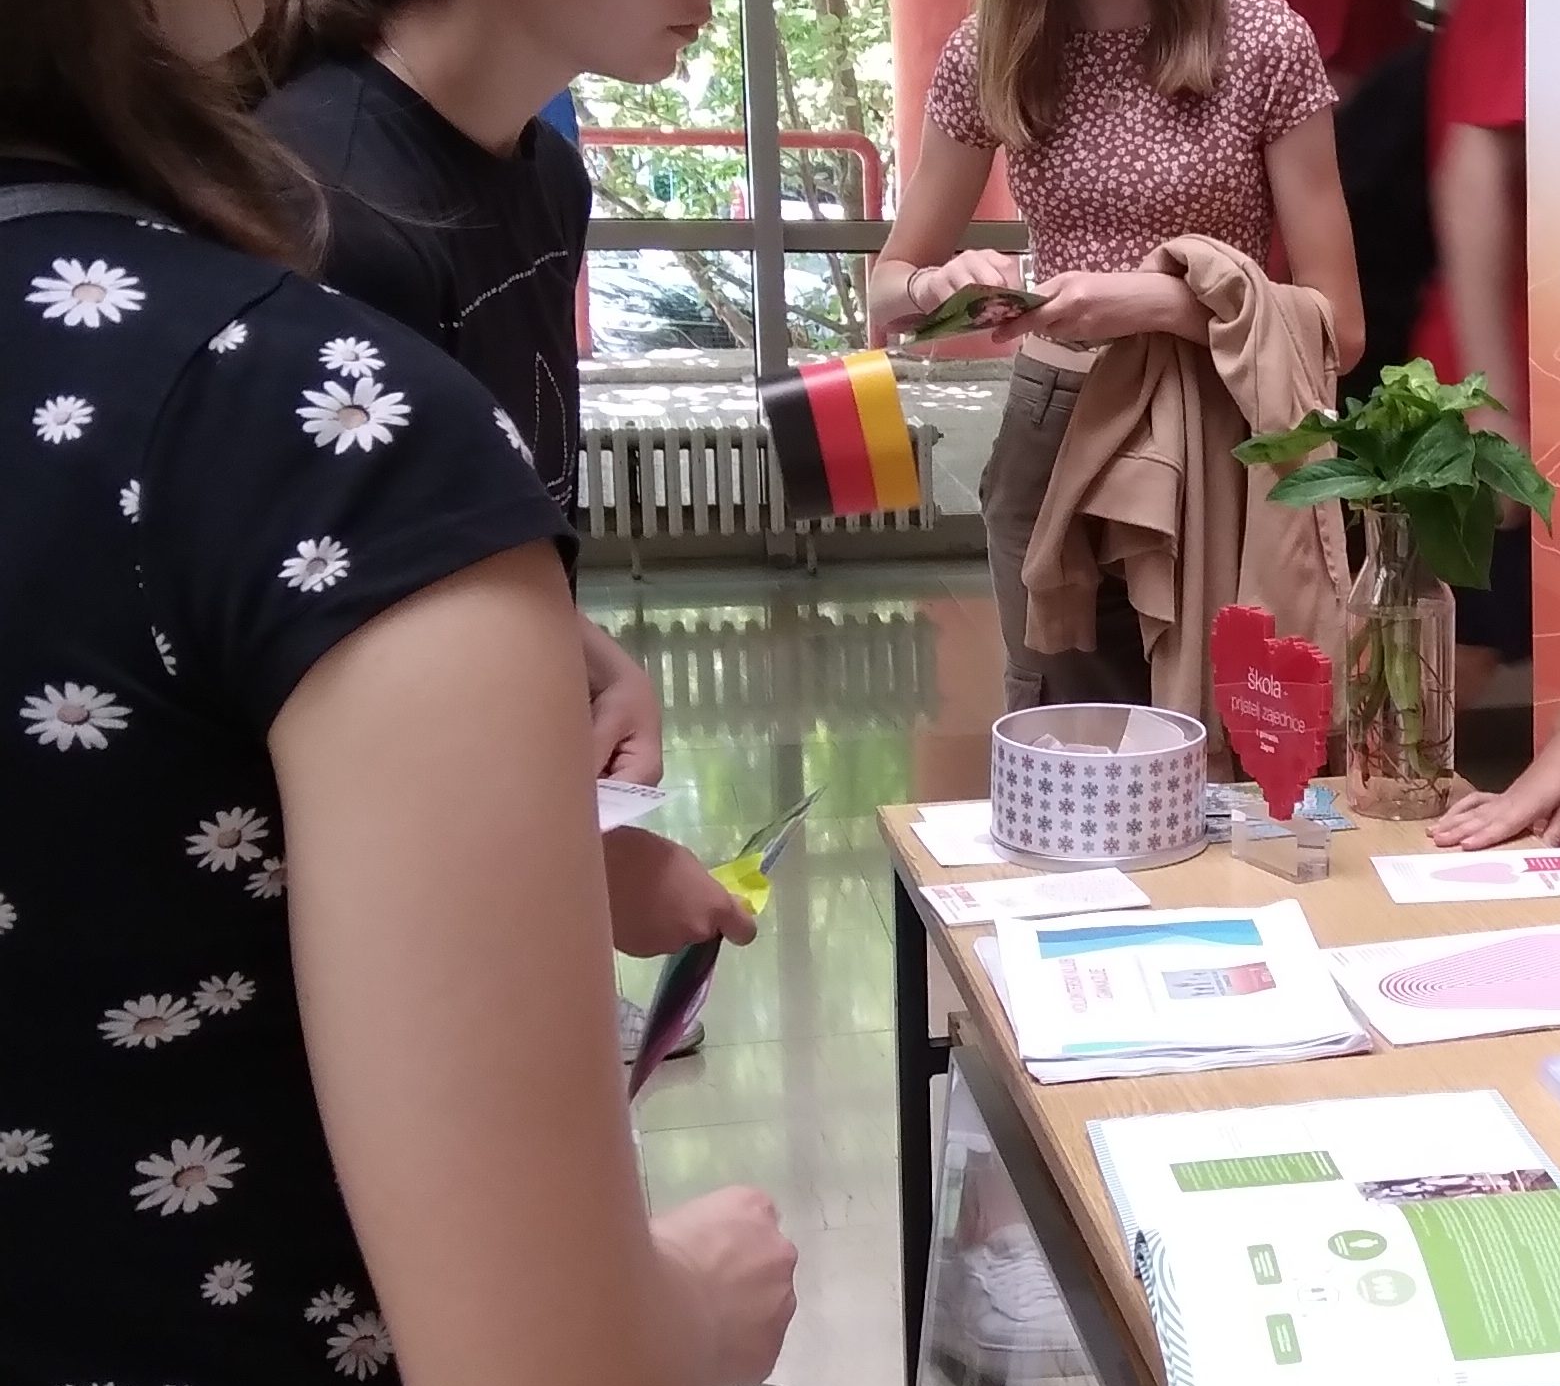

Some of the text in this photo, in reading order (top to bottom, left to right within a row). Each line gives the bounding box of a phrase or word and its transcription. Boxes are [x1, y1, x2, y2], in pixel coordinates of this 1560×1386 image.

[1247, 666, 1282, 699] škola
[1231, 695, 1306, 734] prijatelj zajednice
